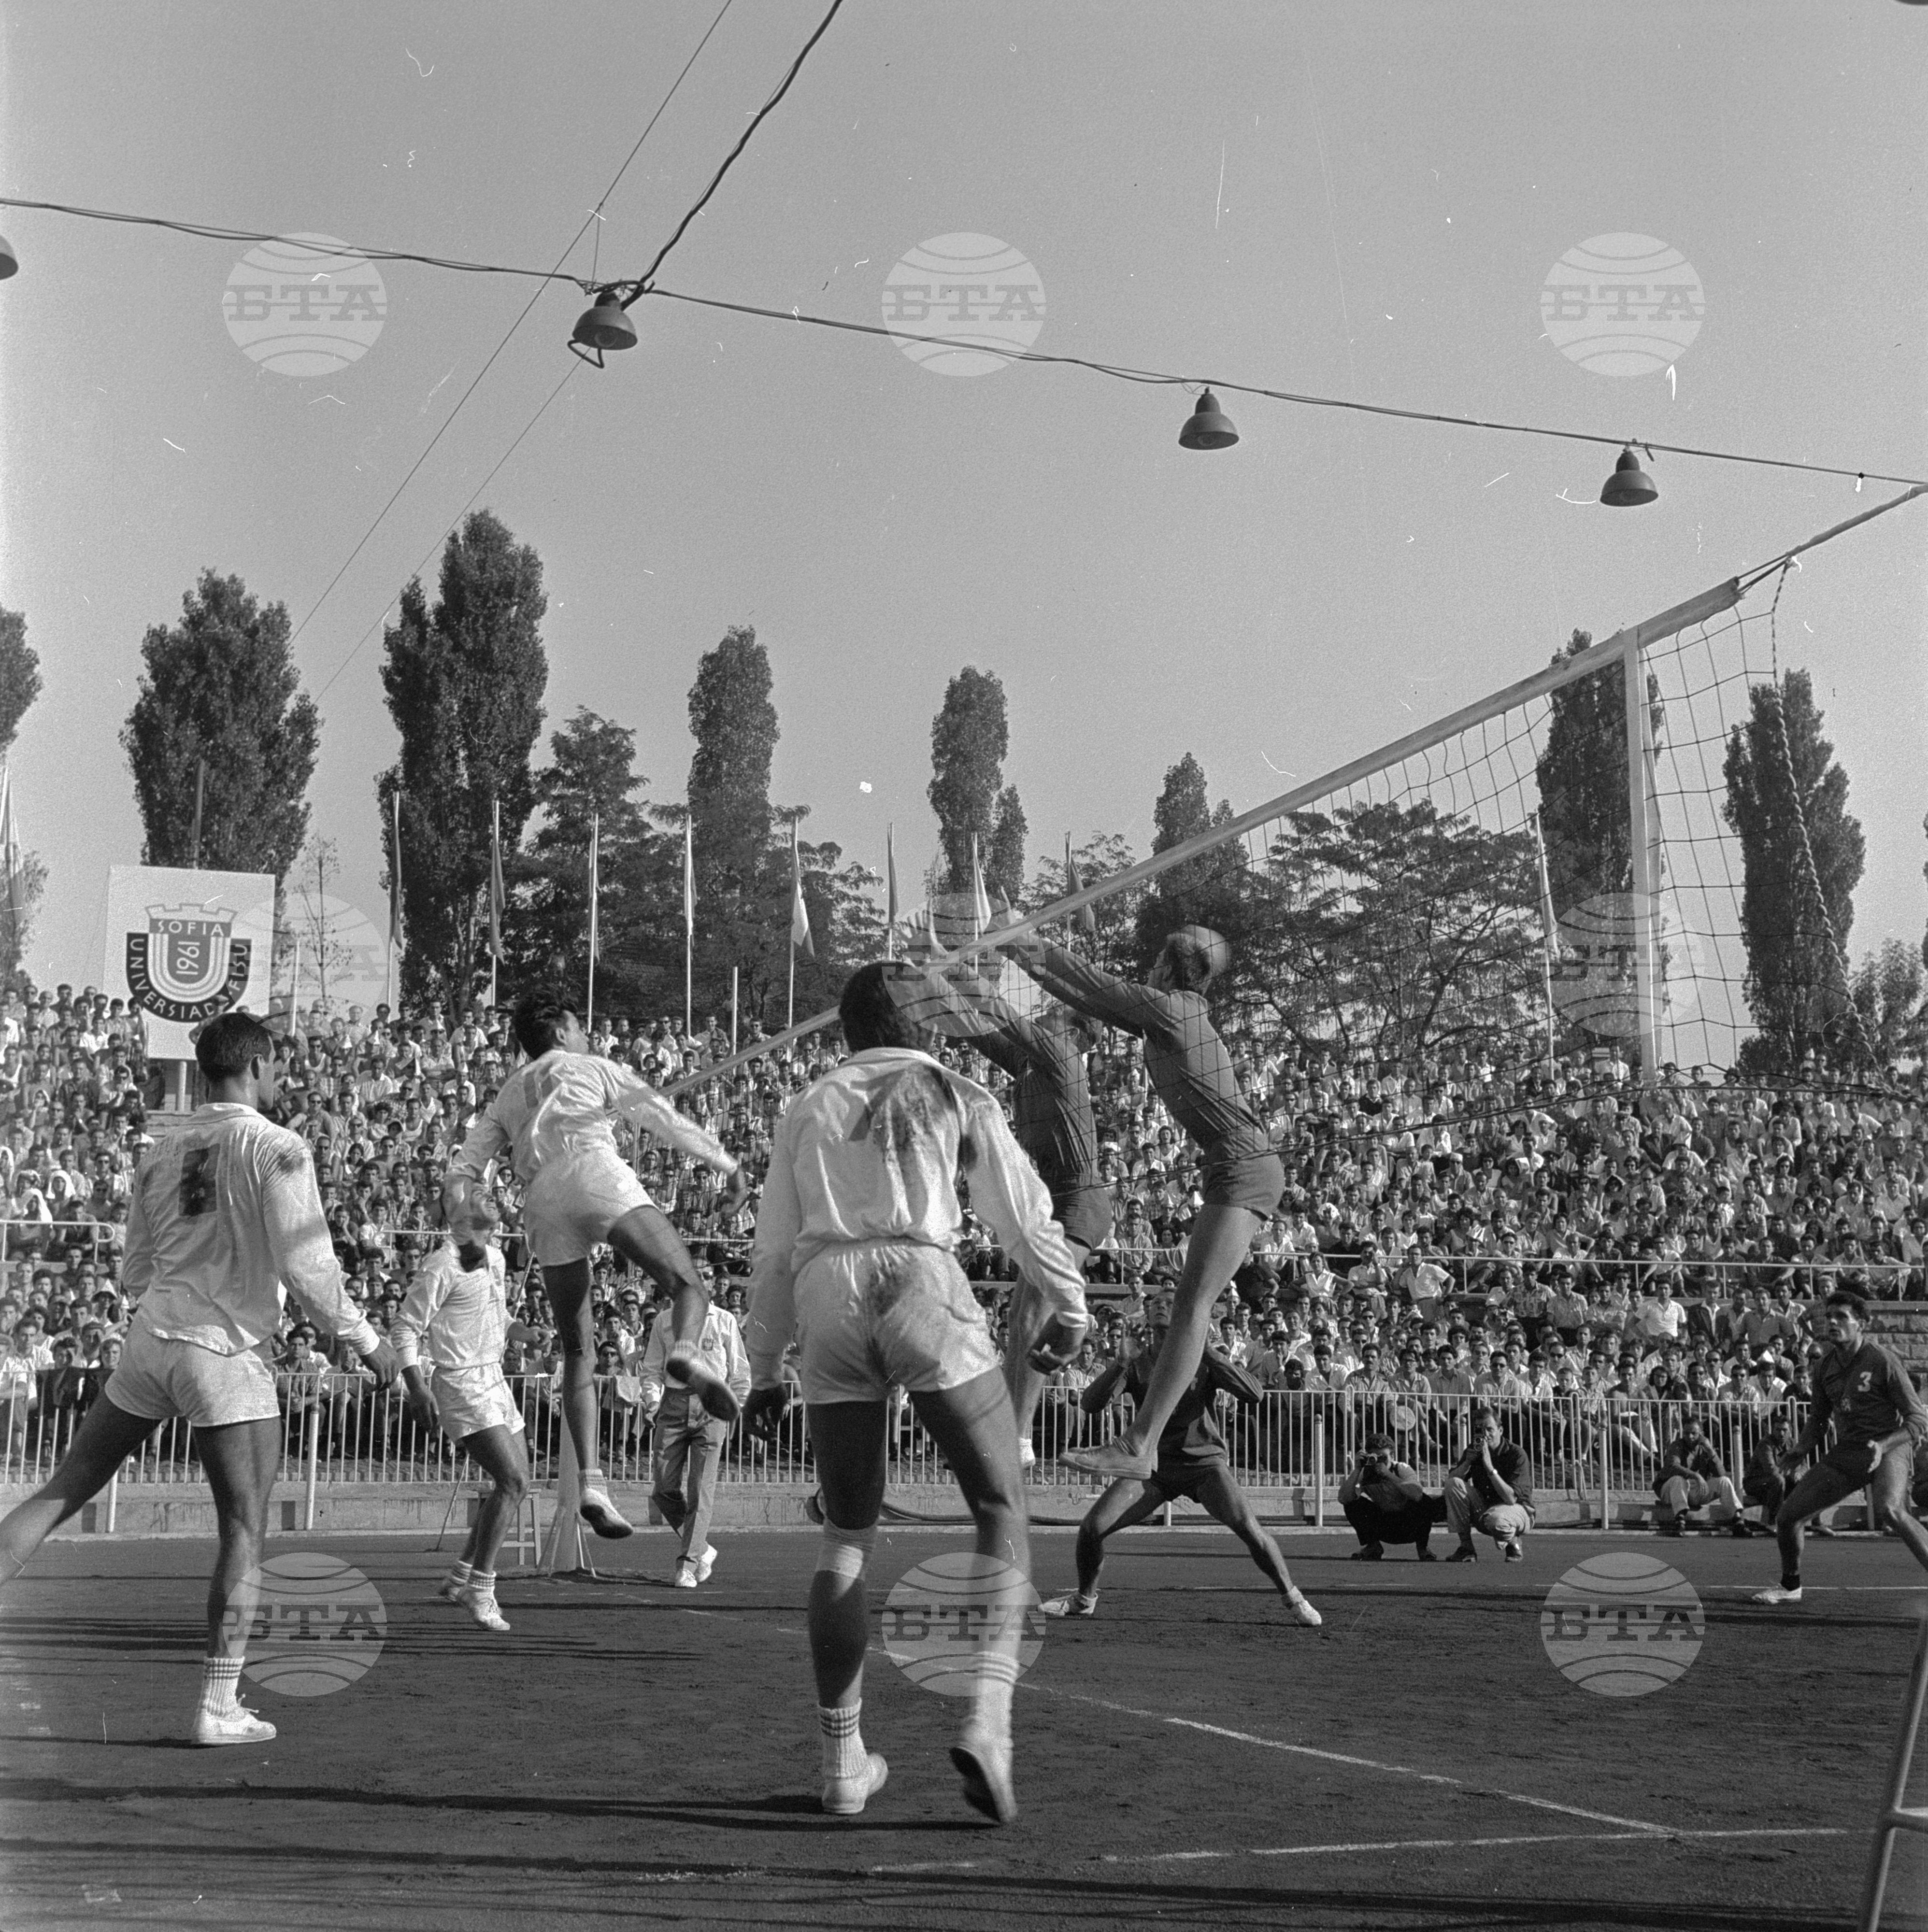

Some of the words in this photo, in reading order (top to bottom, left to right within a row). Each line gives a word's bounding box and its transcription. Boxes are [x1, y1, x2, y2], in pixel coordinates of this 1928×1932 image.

[157, 921, 224, 937] SOFIA
[176, 941, 200, 975] 1961
[130, 938, 229, 1019] UNIVERSIAD
[229, 944, 247, 991] FISU
[1858, 1371, 1873, 1392] 3
